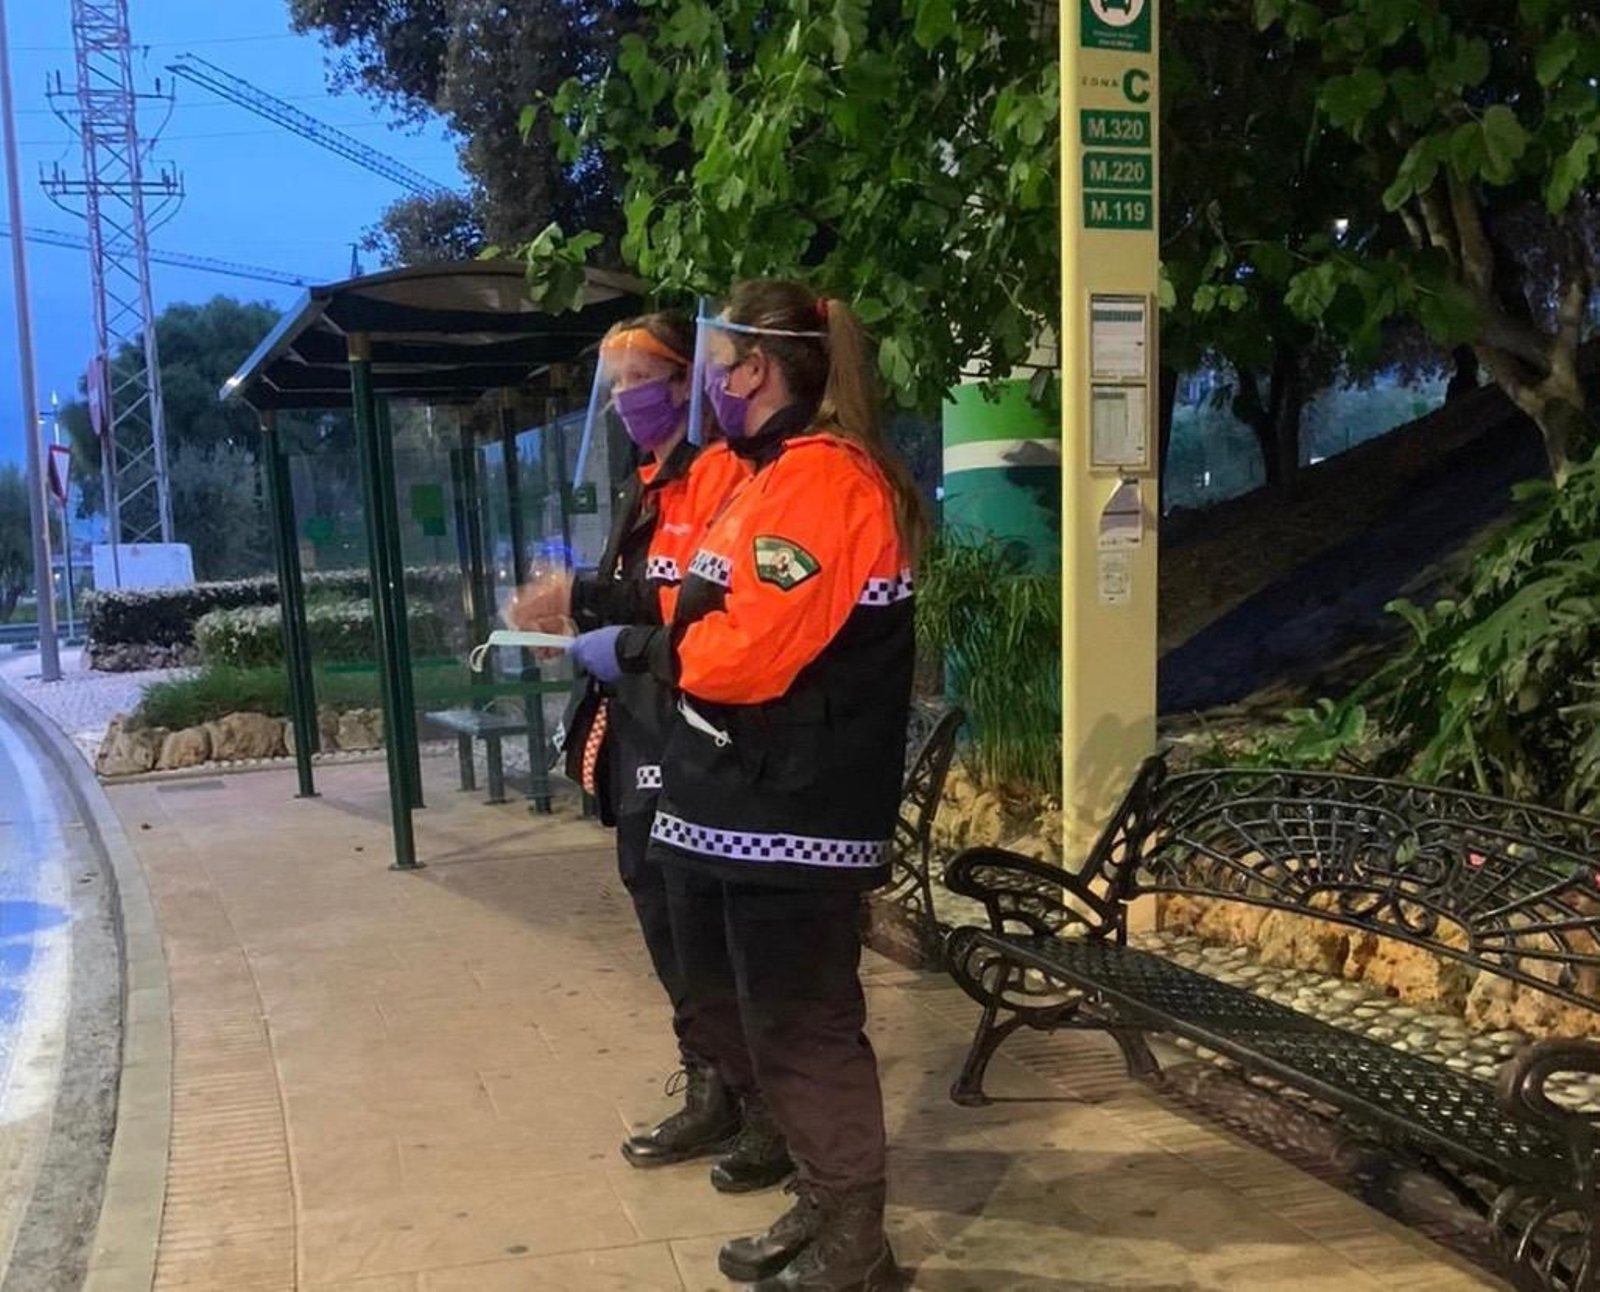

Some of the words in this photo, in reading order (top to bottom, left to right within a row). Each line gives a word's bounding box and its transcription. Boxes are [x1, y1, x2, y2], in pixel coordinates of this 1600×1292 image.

[1122, 68, 1150, 104] C
[1087, 117, 1144, 140] M.320
[1089, 160, 1146, 182] M.220
[1091, 200, 1146, 222] M.119
